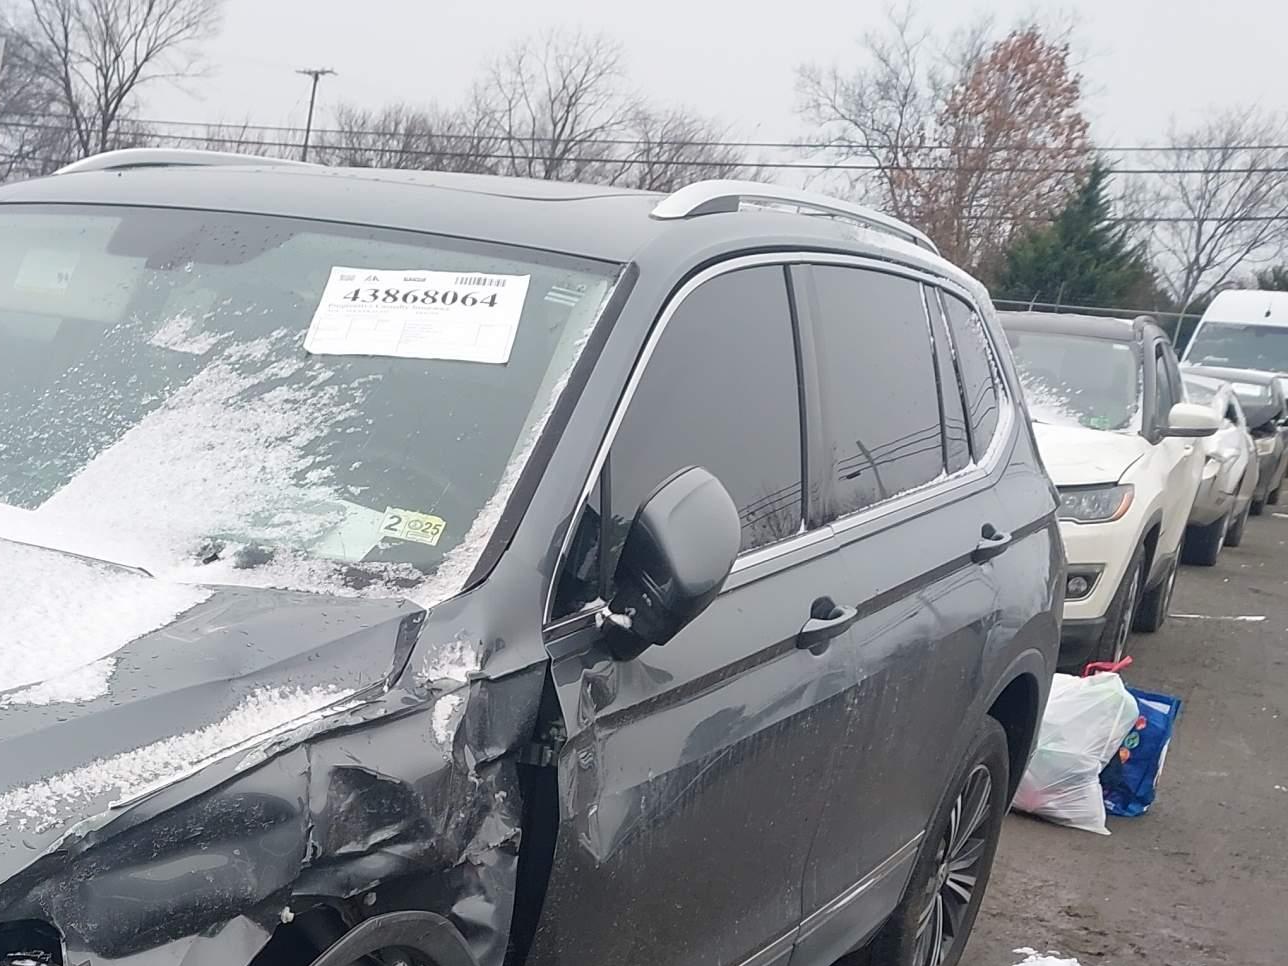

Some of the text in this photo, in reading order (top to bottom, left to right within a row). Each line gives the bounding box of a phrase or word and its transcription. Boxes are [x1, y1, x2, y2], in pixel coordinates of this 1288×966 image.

[343, 288, 499, 307] 43868064
[384, 515, 402, 532] 2
[421, 521, 442, 536] 25
